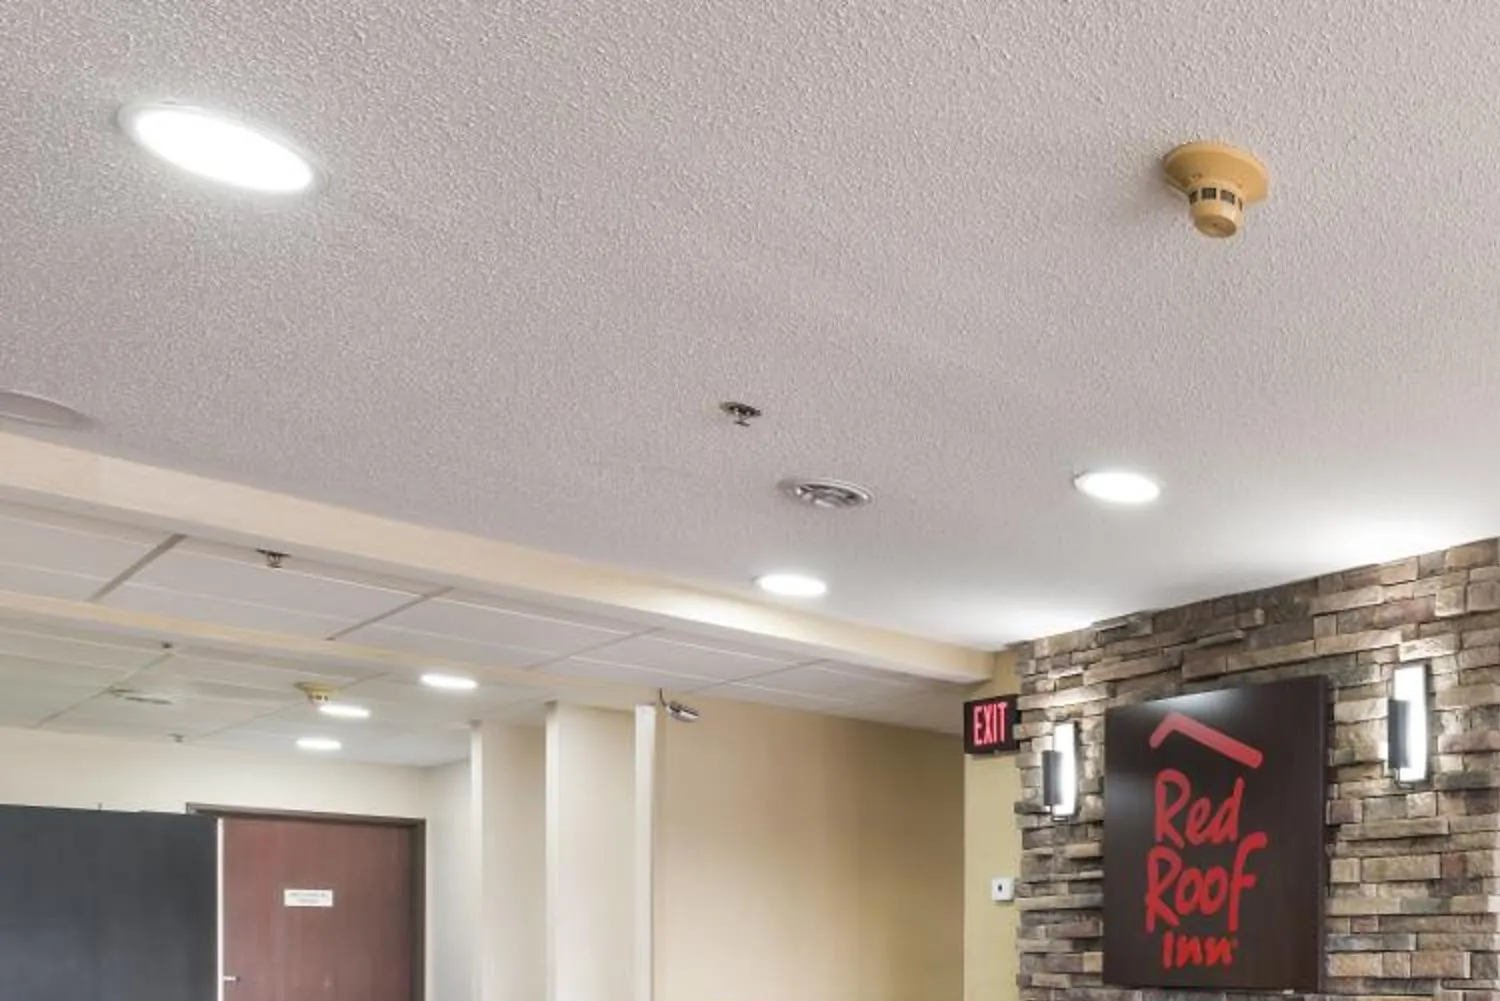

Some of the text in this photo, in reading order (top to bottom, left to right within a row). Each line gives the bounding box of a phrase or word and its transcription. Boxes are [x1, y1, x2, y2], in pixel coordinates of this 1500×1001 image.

[973, 702, 1007, 746] EXIT
[1154, 769, 1245, 848] Red
[1145, 831, 1267, 932] Roof
